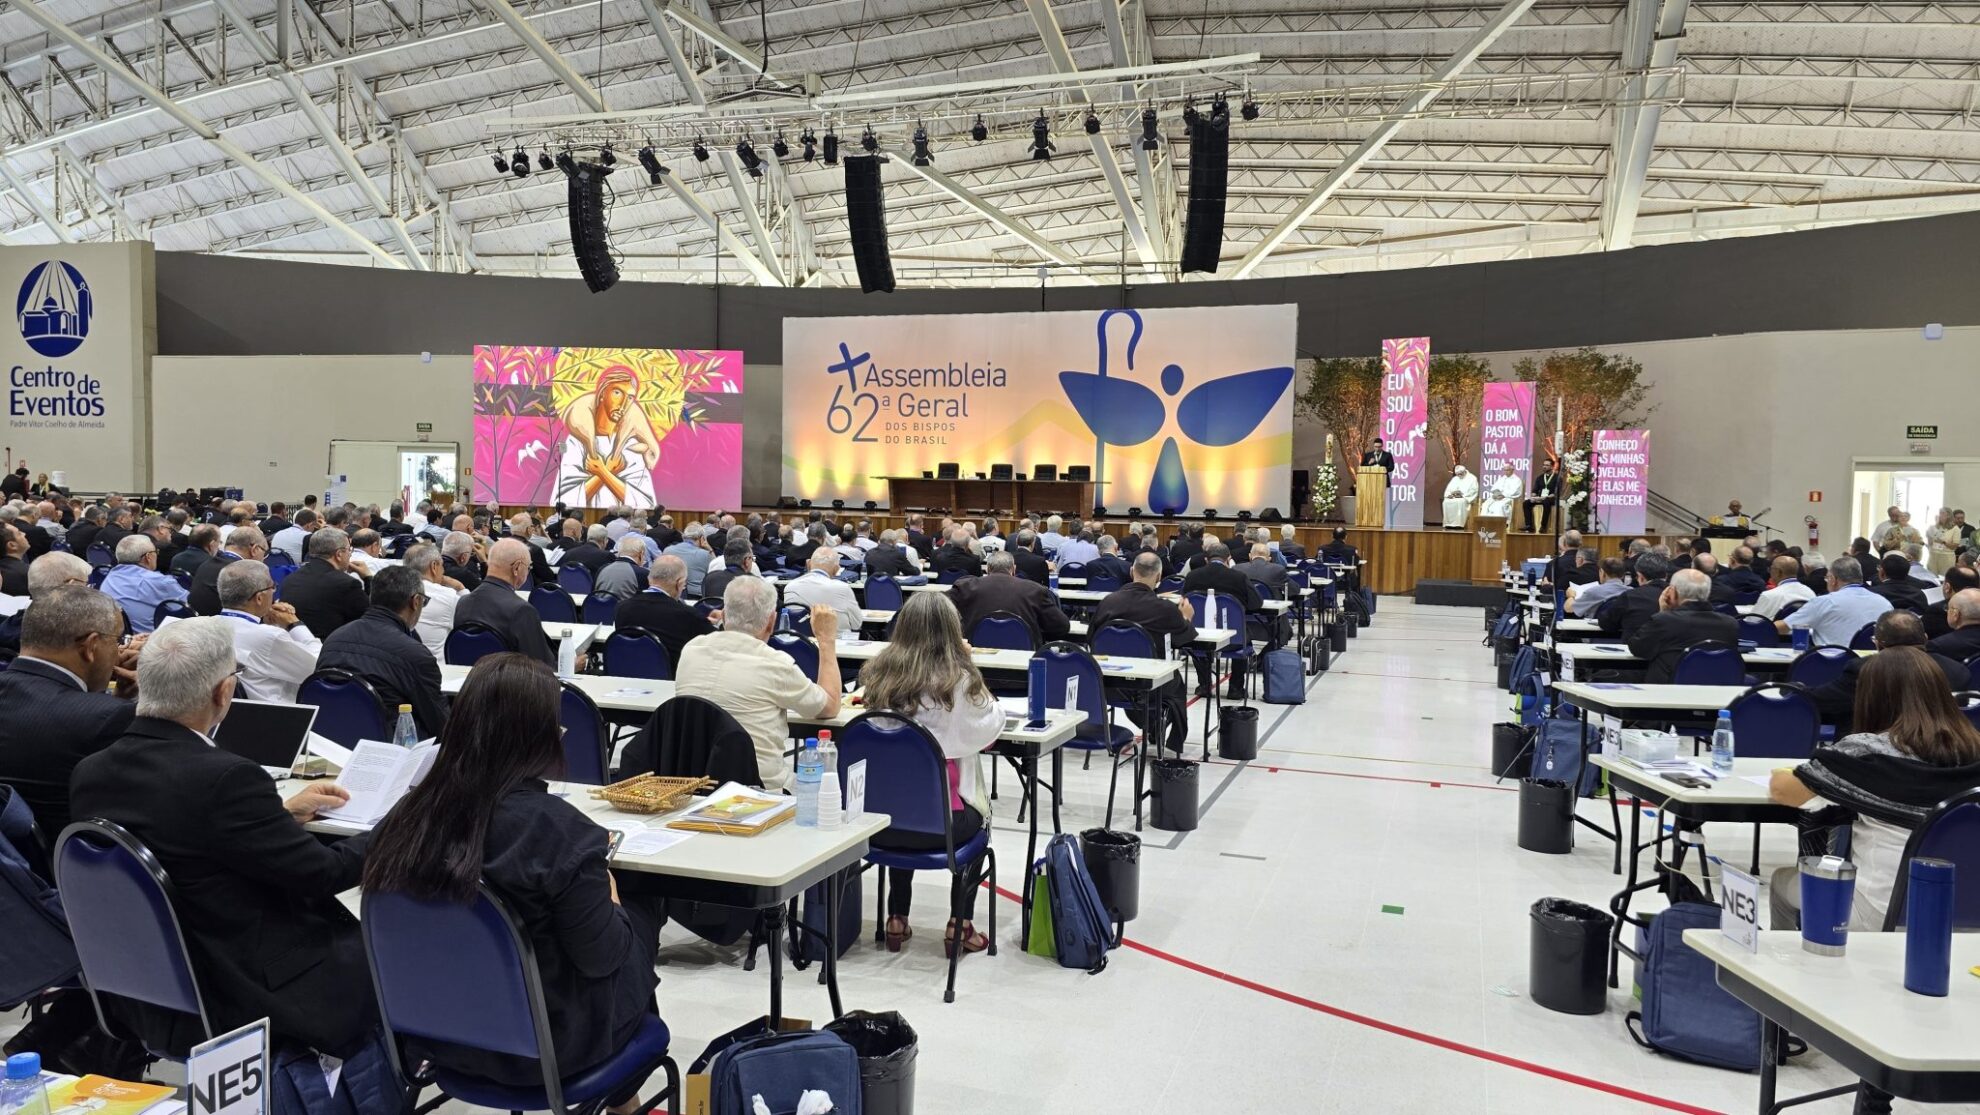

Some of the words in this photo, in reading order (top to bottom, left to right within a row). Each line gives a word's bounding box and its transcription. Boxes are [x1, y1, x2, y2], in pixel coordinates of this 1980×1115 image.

[10, 366, 75, 387] Centro
[77, 374, 100, 395] de
[864, 362, 1006, 388] Assembleia
[1387, 374, 1405, 391] EU
[10, 390, 105, 416] Eventos
[898, 392, 968, 418] Geral
[1386, 396, 1413, 413] SOU
[1485, 409, 1493, 422] O
[1495, 409, 1518, 422] BOM
[10, 420, 28, 429] Padre
[29, 420, 43, 428] Vitor
[45, 420, 67, 429] Coelho
[68, 420, 77, 429] de
[78, 420, 105, 429] Almeida
[885, 422, 908, 431] DOS
[913, 422, 956, 431] BISPOS
[1386, 418, 1395, 435] O
[1485, 425, 1524, 438] PASTOR
[885, 436, 900, 444] DO
[905, 436, 948, 444] BRASIL
[1484, 439, 1498, 455] DÁ
[1500, 442, 1508, 454] A
[1610, 453, 1645, 464] MINHAS
[1603, 481, 1625, 492] ELAS
[1626, 481, 1640, 492] ME
[850, 774, 864, 802] N2
[1722, 885, 1756, 924] NE3
[187, 1053, 262, 1115] NE5
